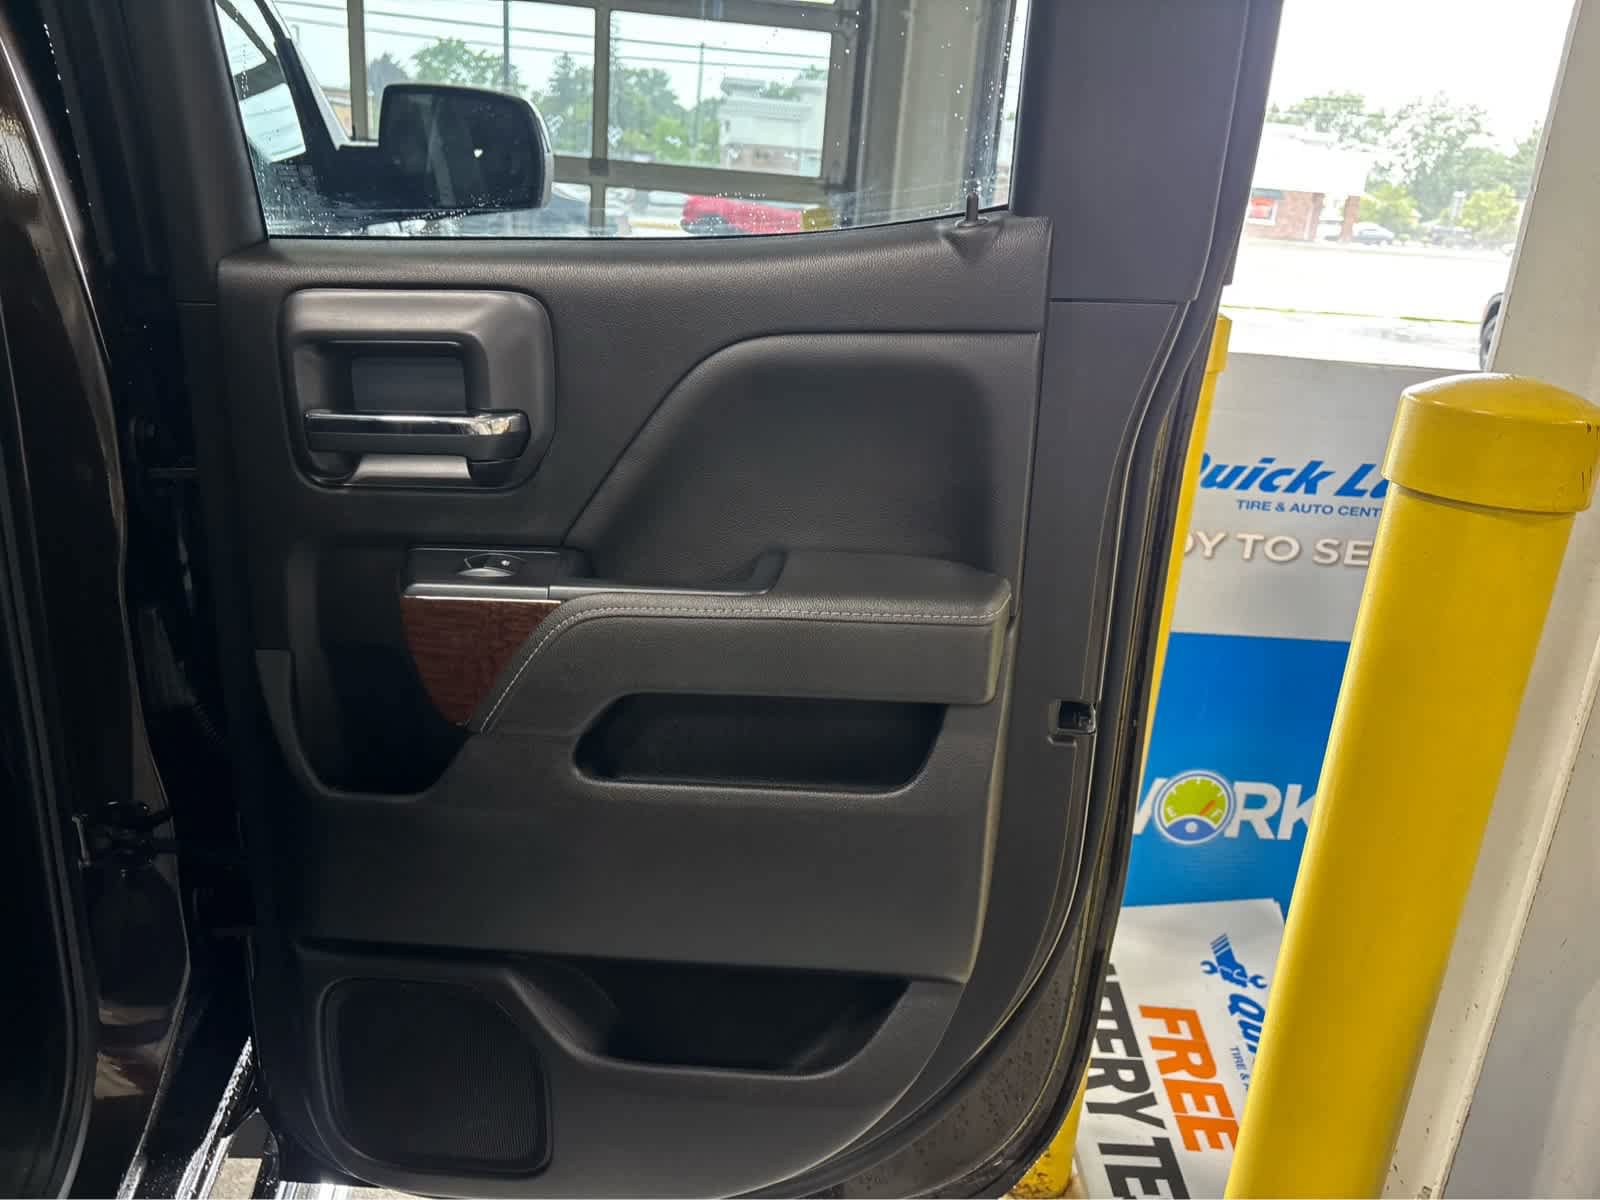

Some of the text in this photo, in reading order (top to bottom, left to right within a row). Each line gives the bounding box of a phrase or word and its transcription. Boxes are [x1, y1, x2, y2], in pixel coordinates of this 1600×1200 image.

[1237, 499, 1383, 518] TIRE & AUTO CENT
[1185, 531, 1374, 567] Y TO SE
[1138, 1005, 1239, 1153] FREE
[1097, 1136, 1191, 1199] TE
